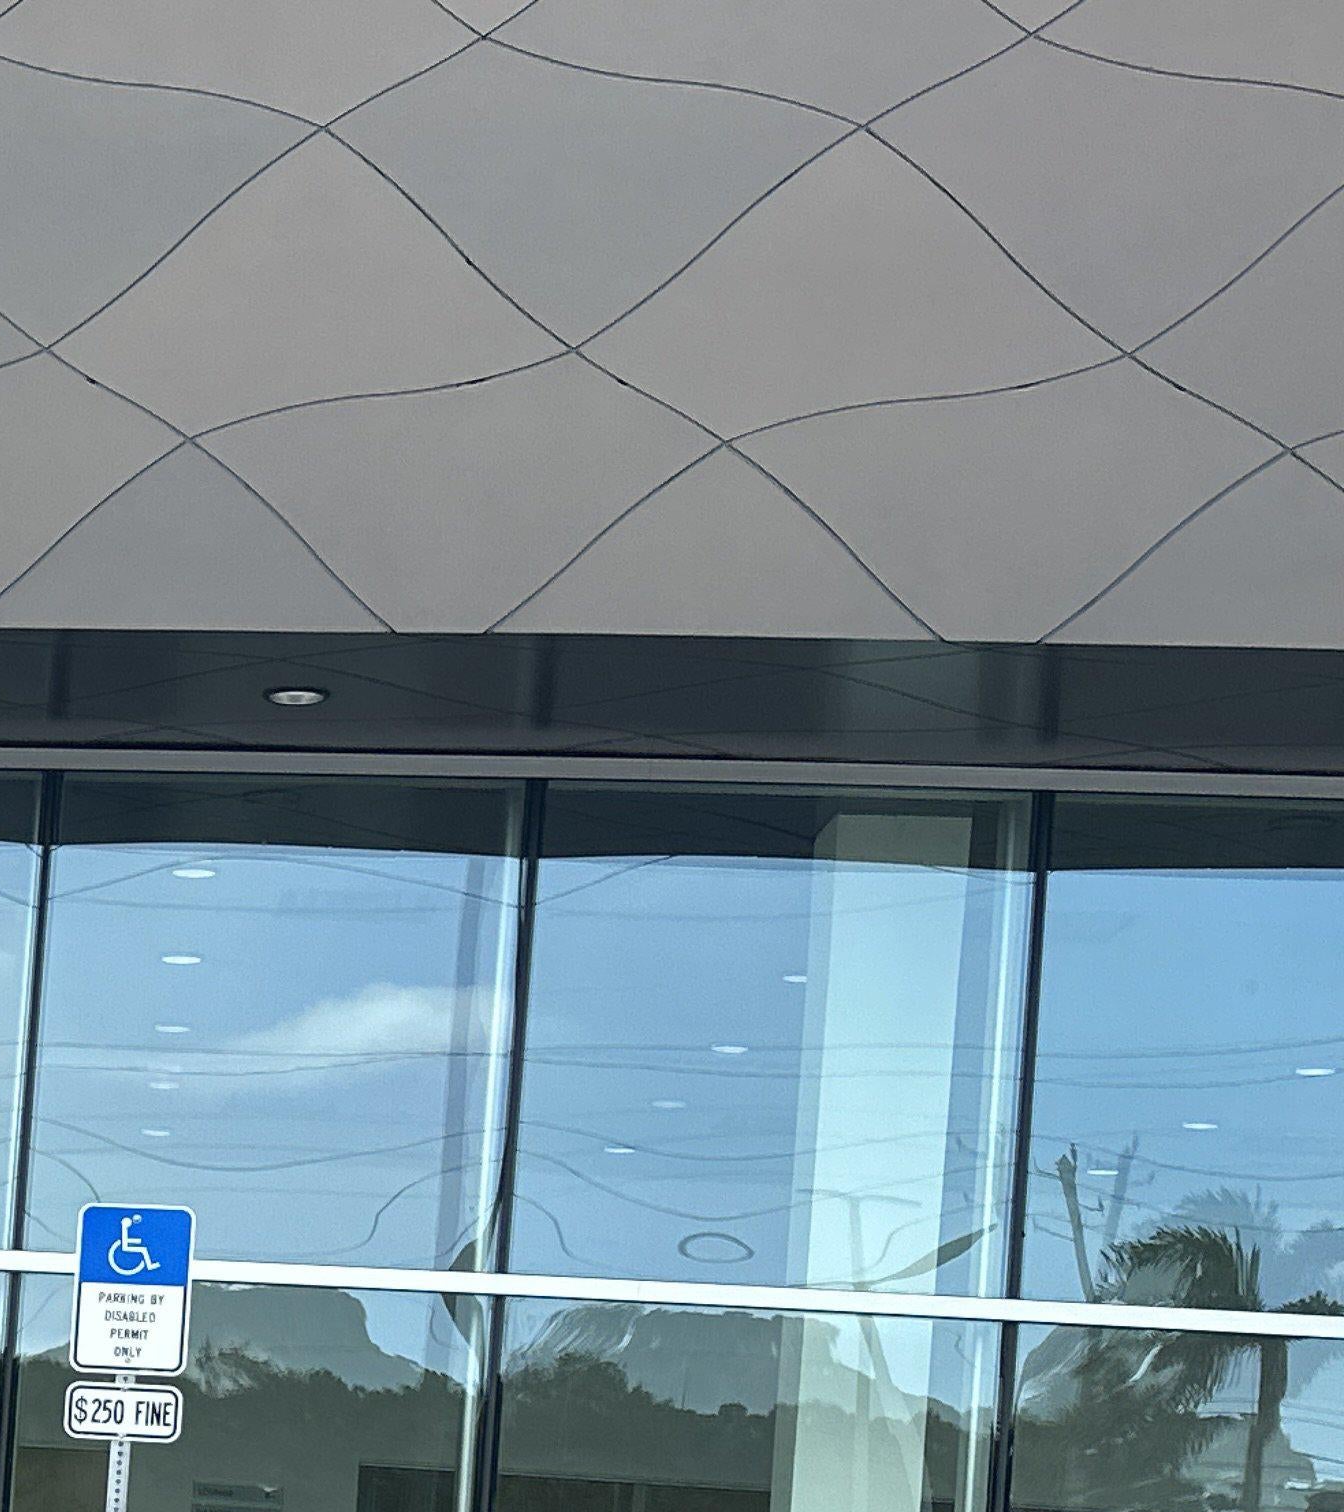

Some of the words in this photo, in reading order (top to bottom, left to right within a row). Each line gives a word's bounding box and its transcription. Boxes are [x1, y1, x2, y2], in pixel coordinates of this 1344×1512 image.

[98, 1291, 145, 1305] PARKING
[150, 1293, 165, 1306] BY
[104, 1310, 156, 1323] DISABLED
[110, 1328, 149, 1341] PERMIT
[114, 1345, 142, 1358] ONLY
[73, 1395, 125, 1425] $250
[134, 1400, 173, 1427] FINE
